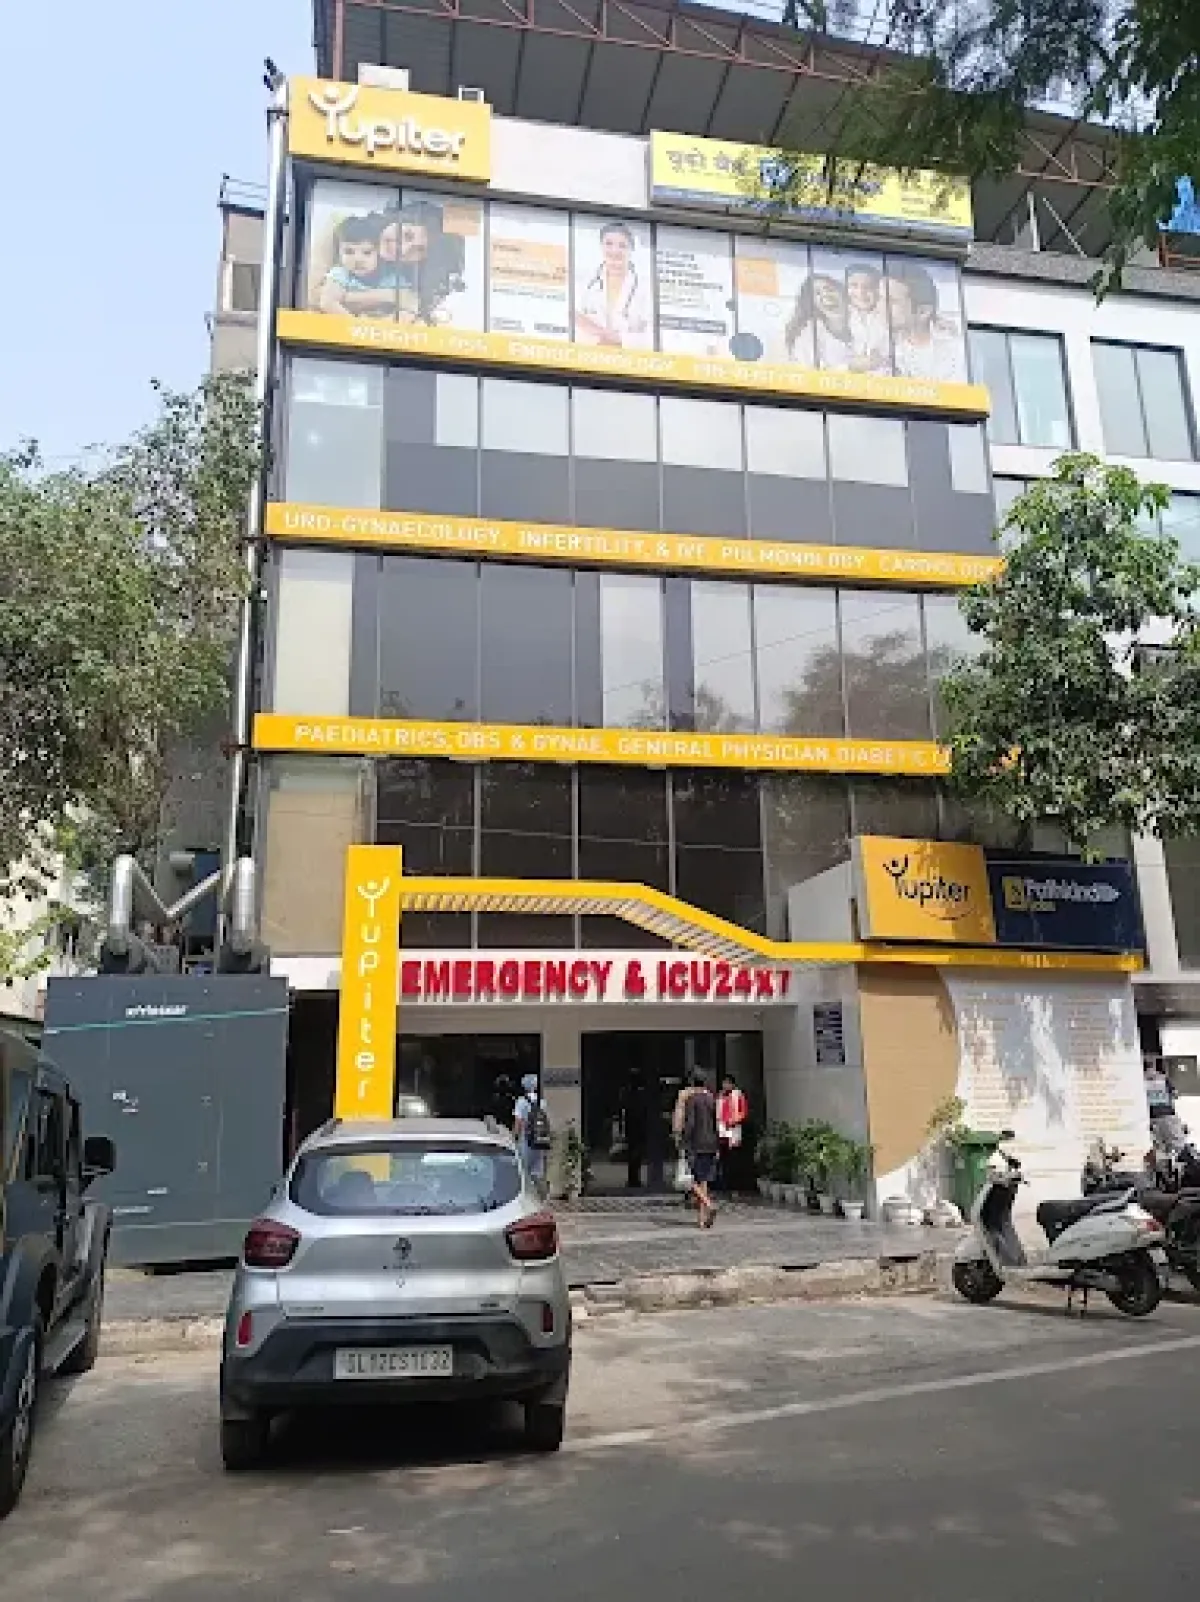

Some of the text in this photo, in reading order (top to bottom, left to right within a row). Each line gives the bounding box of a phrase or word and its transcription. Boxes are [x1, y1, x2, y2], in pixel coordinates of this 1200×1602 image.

[308, 84, 465, 157] Yupiter
[617, 736, 714, 758] GENERAL
[722, 740, 828, 762] PHYSICIAN
[881, 854, 972, 907] Yupiter
[400, 960, 612, 996] EMERGENCY
[624, 960, 647, 996] &
